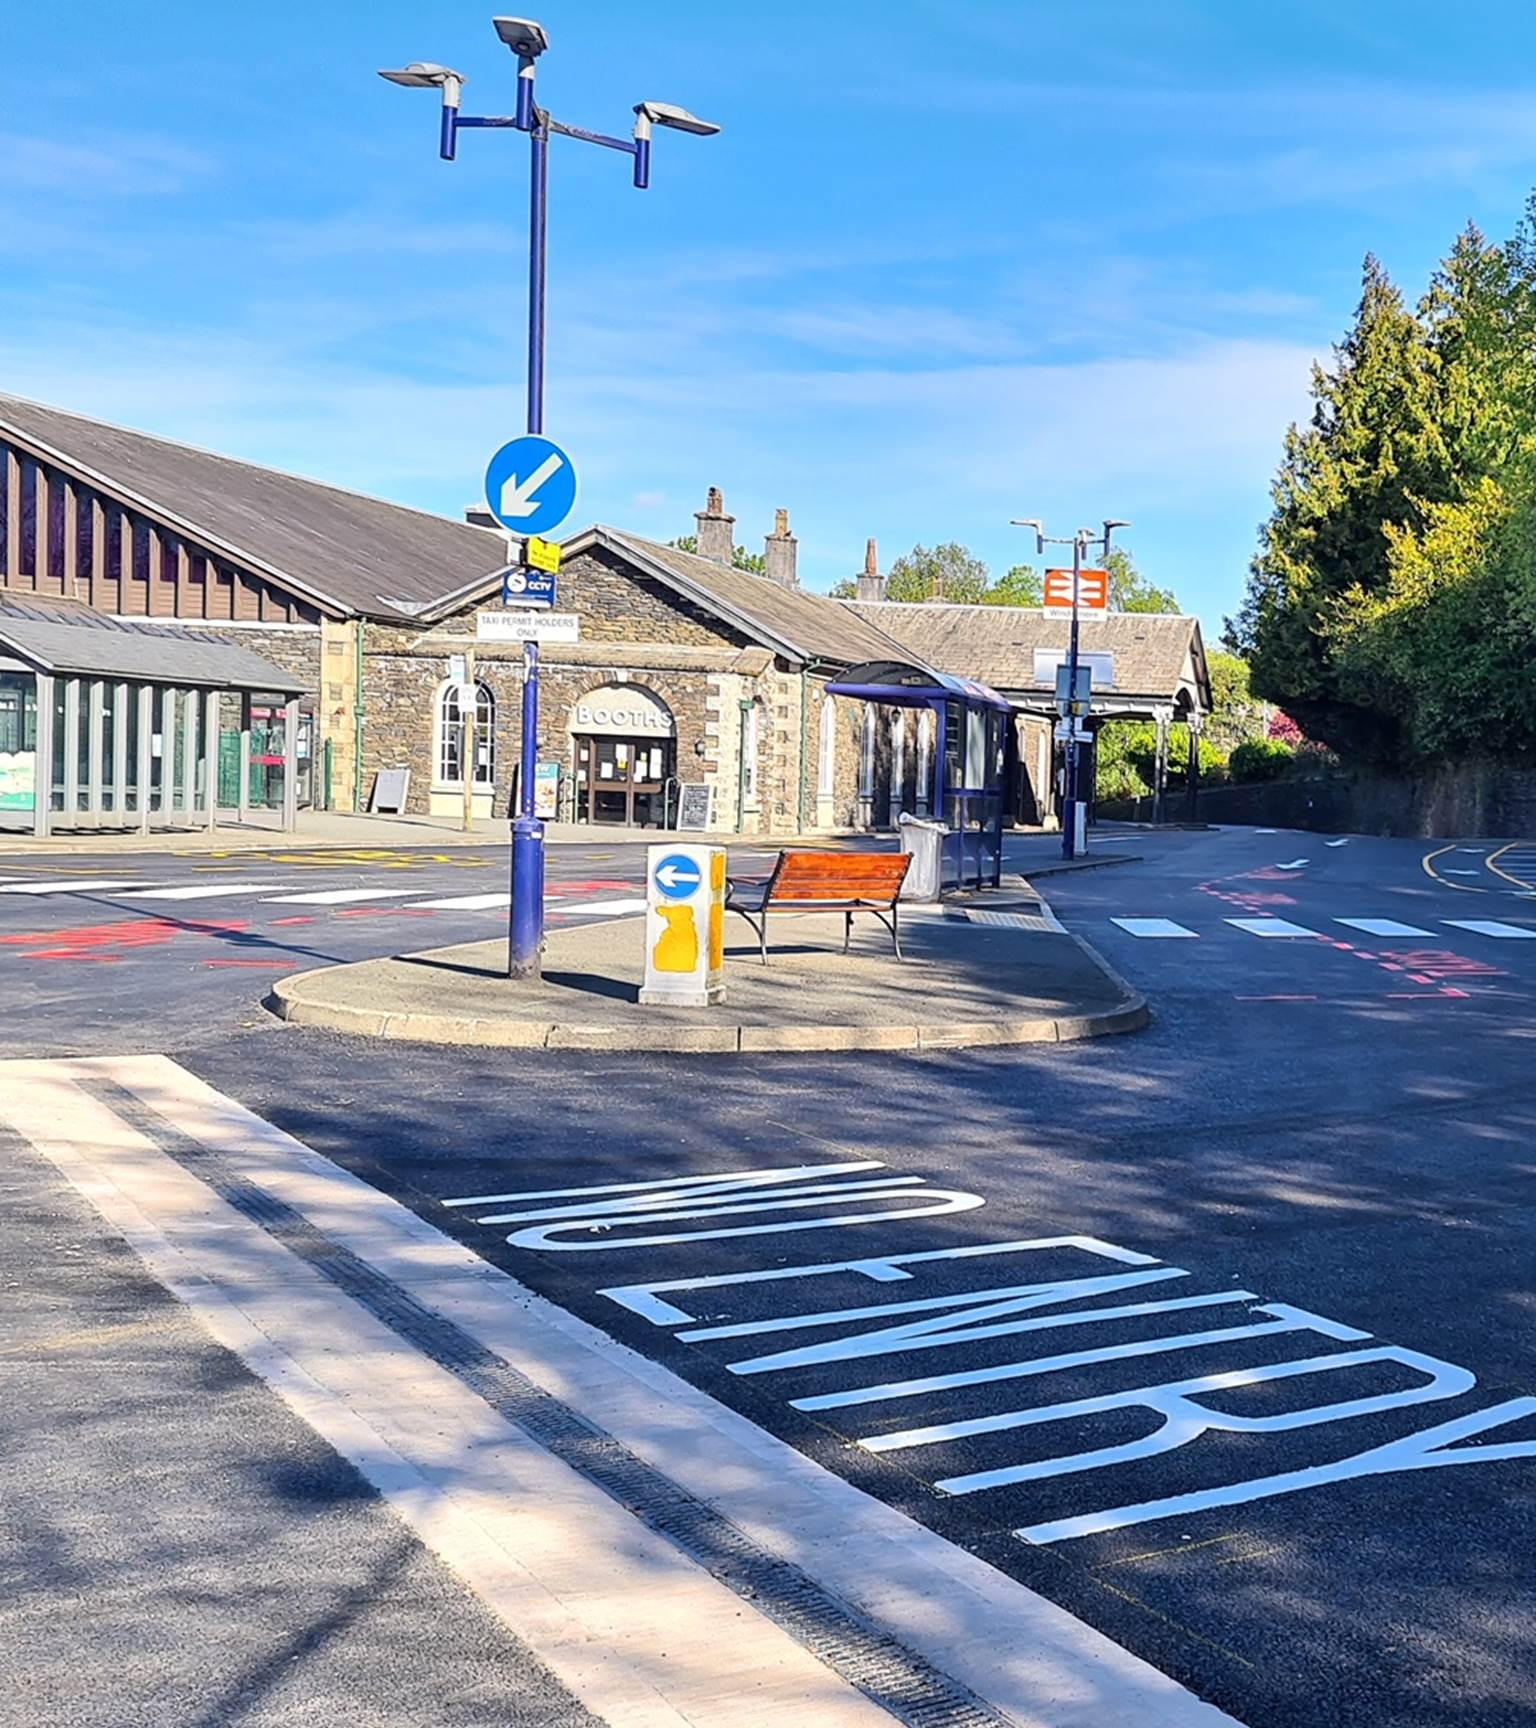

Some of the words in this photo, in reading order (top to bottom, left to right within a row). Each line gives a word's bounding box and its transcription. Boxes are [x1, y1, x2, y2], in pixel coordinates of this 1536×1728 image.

[528, 580, 552, 591] CCTV
[1049, 609, 1099, 618] Windmere
[481, 615, 499, 625] TAXI
[502, 616, 532, 626] PERMIT
[535, 618, 575, 628] HOLDERS
[516, 628, 538, 637] ONLY
[577, 705, 673, 728] BOOTHS
[442, 1160, 986, 1251] NO
